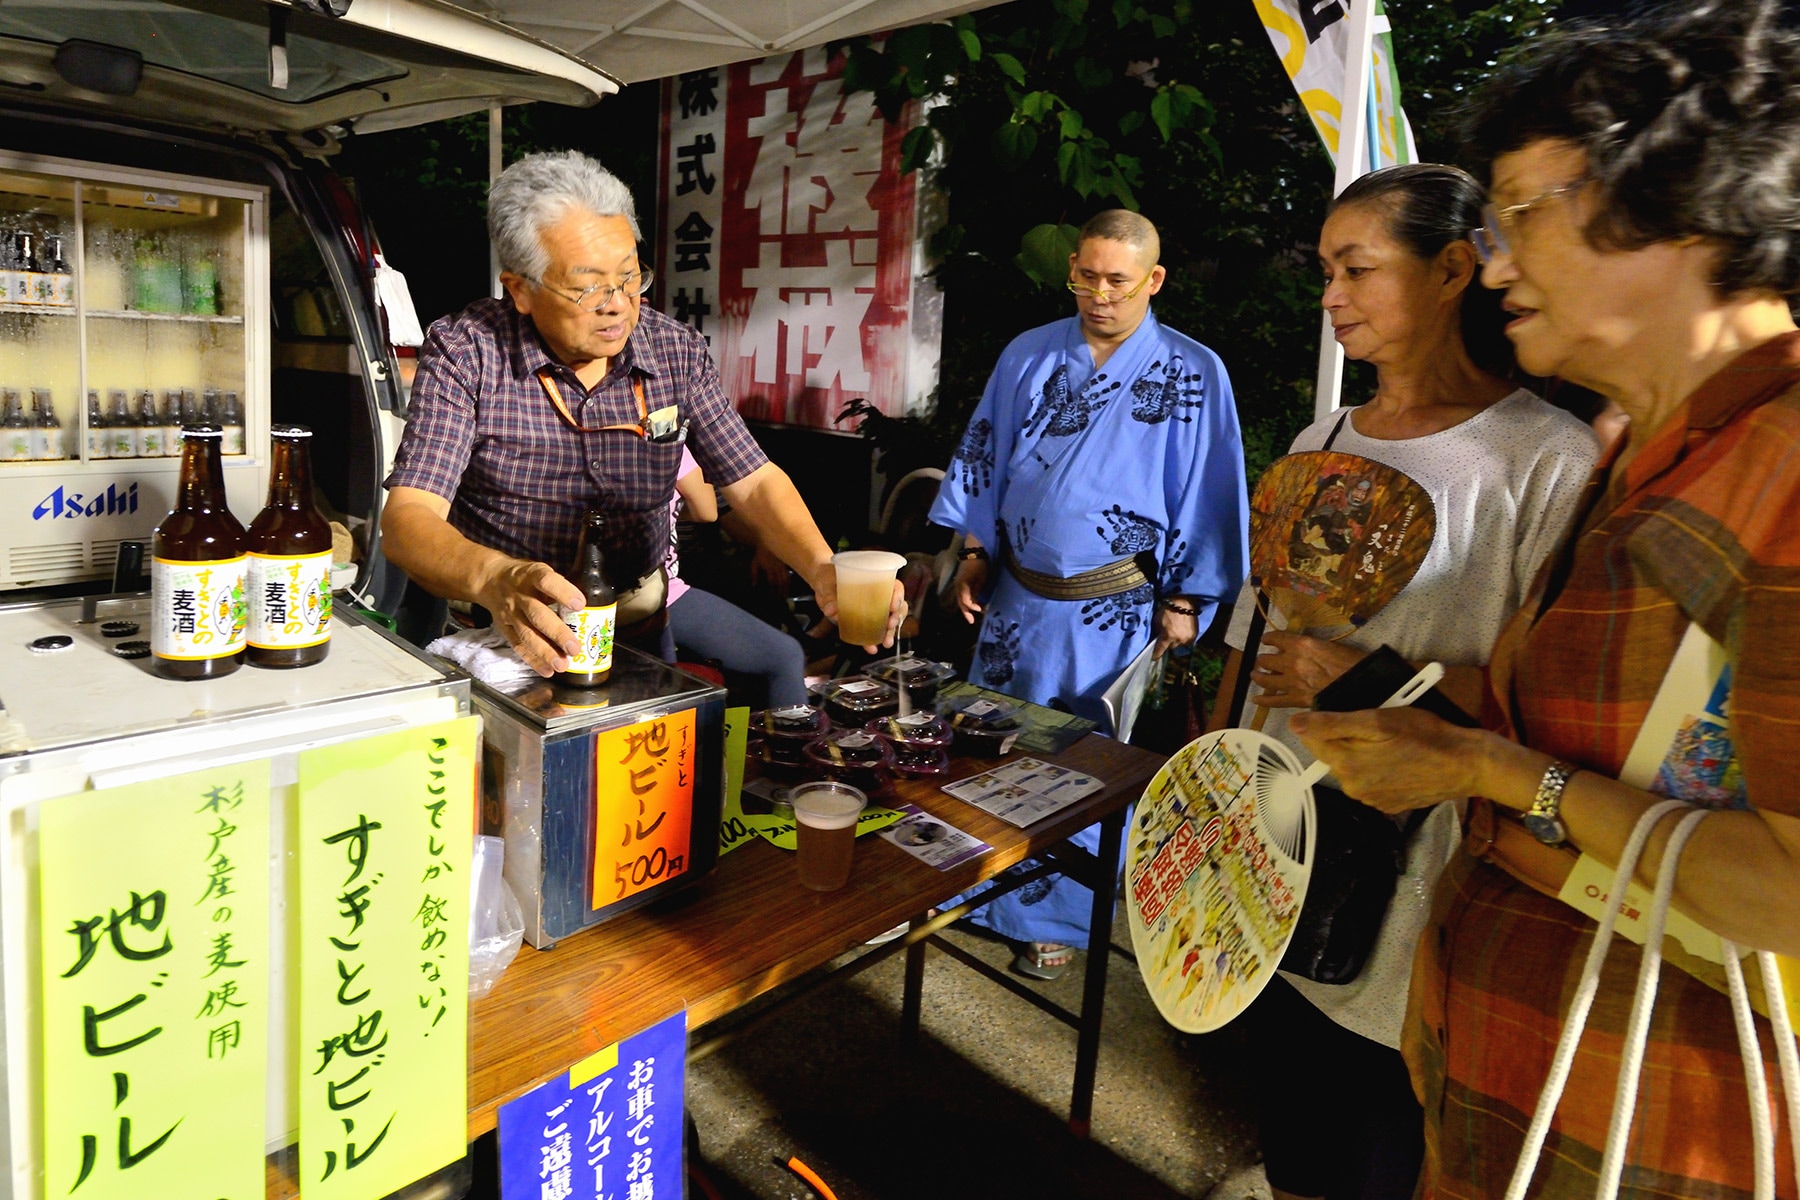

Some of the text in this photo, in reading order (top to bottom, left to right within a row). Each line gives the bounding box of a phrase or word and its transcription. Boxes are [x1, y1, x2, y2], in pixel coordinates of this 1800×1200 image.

[673, 66, 719, 347] 株式会社
[32, 482, 138, 520] Asahi
[172, 589, 196, 634] 麦酒
[192, 568, 215, 645] すぎとの
[265, 581, 287, 625] 麦酒
[283, 562, 305, 635] すぎとの
[619, 722, 671, 847] 地ビール
[677, 725, 691, 788] すぎと
[615, 846, 684, 899] 500円
[194, 779, 249, 1060] 杉戸産の麦使用
[60, 890, 185, 1196] 地ビール
[313, 814, 397, 1183] すぎと地ビール
[538, 1098, 573, 1200] ご遠慮
[584, 1077, 615, 1200] アルコー
